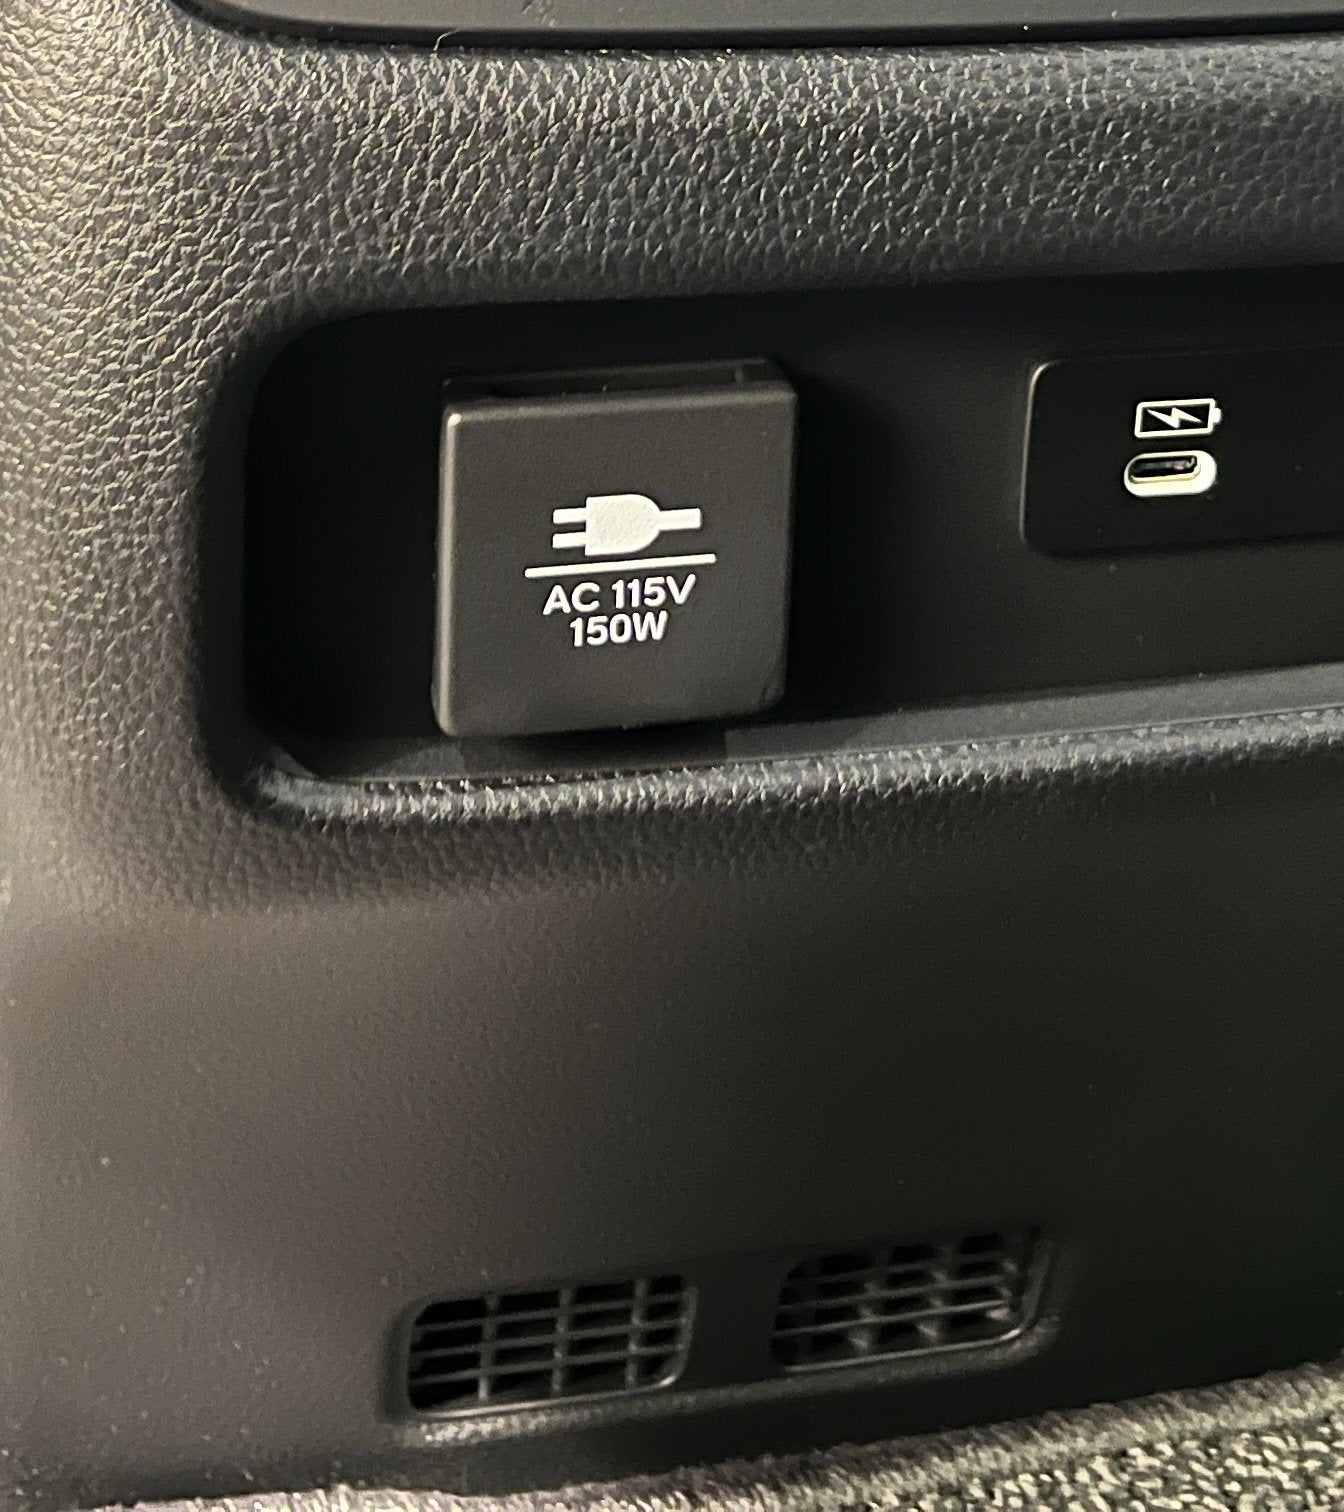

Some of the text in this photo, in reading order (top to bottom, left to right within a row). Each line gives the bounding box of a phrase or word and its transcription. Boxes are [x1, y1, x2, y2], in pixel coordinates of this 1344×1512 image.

[542, 573, 697, 615] AC 115V
[569, 610, 668, 647] 150W
